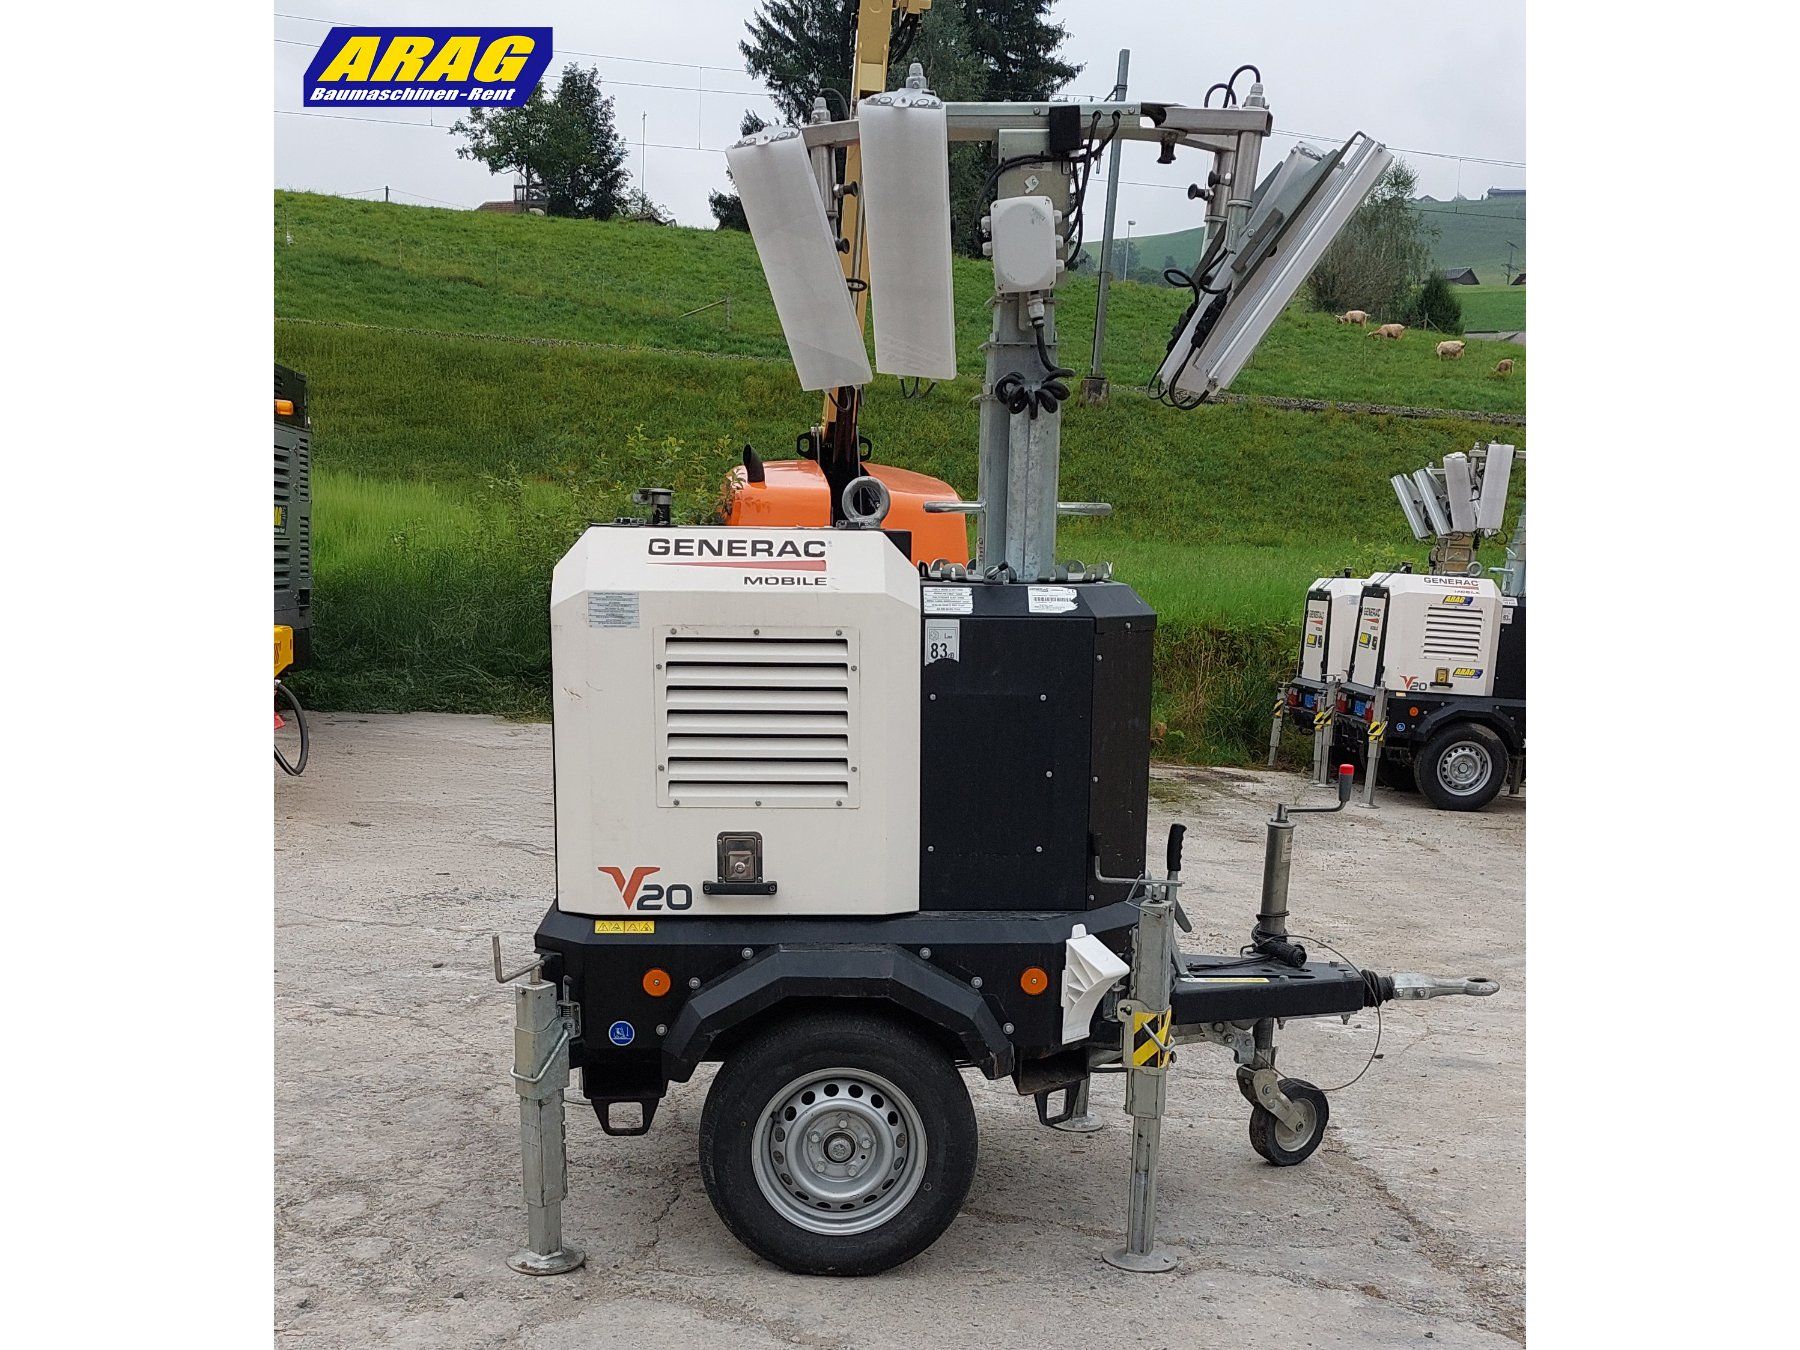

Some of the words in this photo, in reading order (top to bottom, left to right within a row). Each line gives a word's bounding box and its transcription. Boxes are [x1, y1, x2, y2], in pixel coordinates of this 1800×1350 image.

[648, 538, 826, 558] GENERAC
[744, 576, 828, 586] MOBILE
[1424, 577, 1479, 587] GENERAC
[931, 642, 948, 659] 83
[1399, 675, 1428, 691] V20
[597, 866, 693, 911] V20
